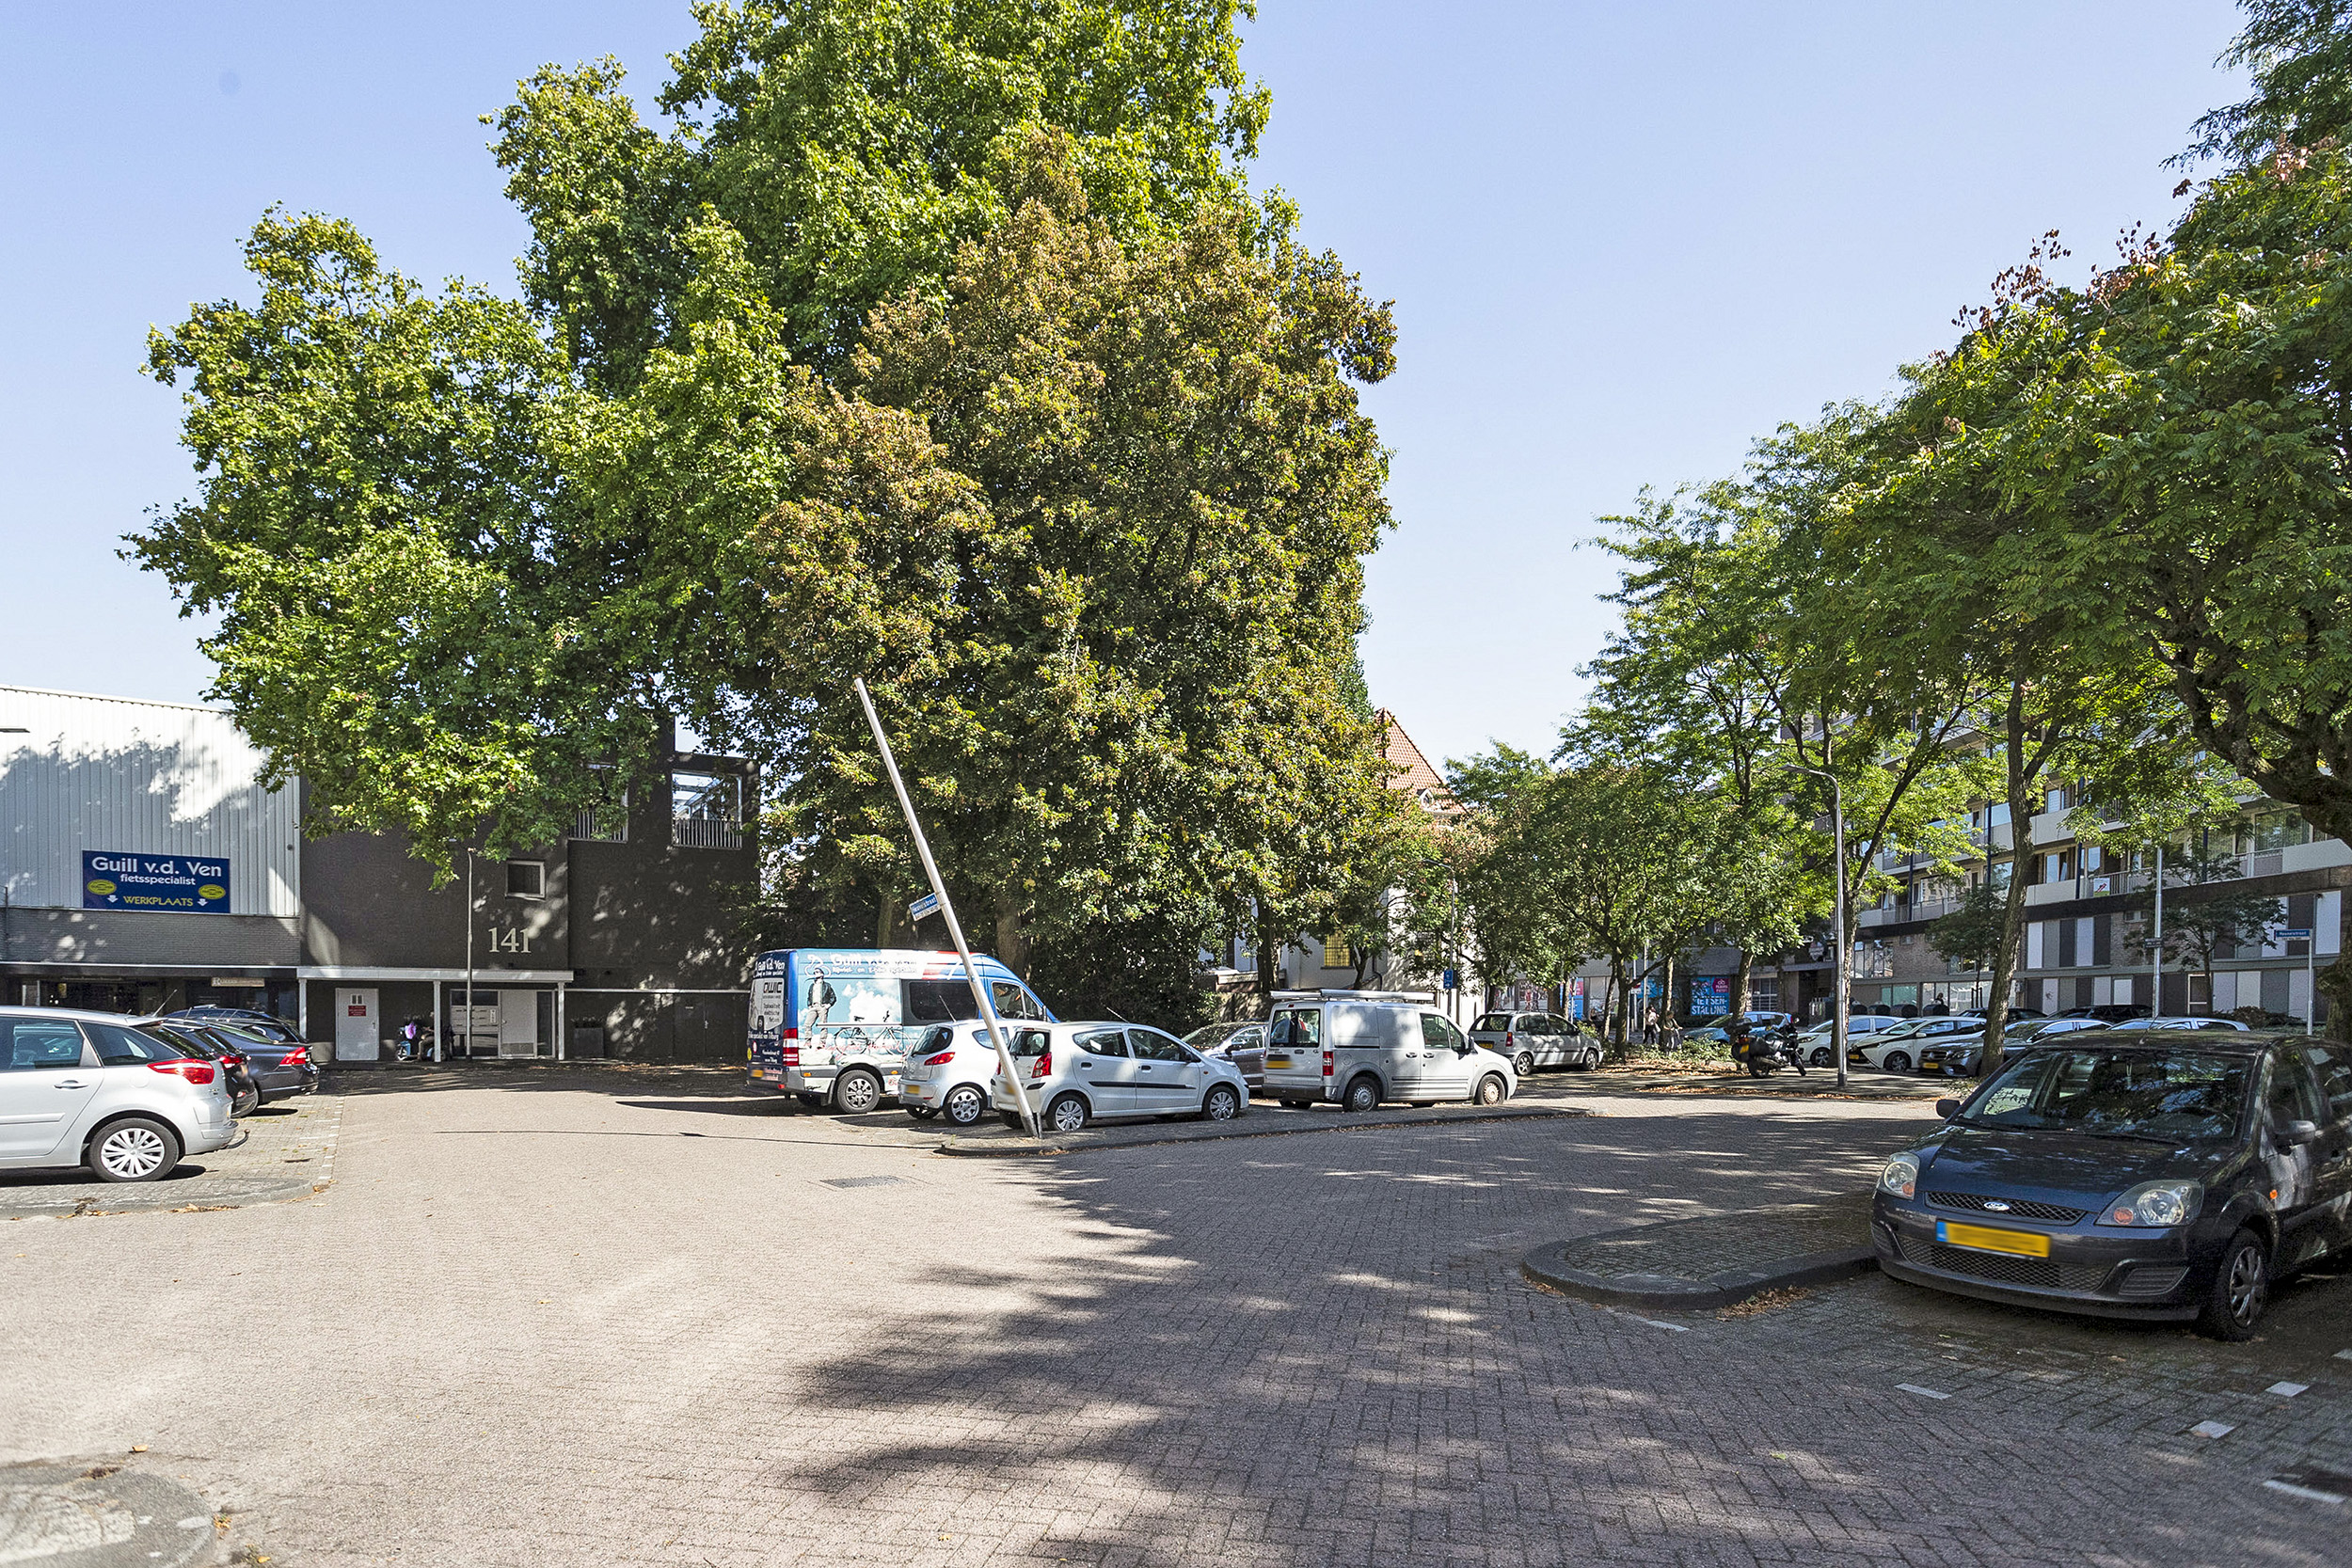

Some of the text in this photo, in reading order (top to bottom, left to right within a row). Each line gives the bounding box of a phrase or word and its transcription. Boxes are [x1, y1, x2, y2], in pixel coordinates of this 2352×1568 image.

[91, 857, 223, 879] Guill v.d. Ven
[120, 874, 196, 885] fietsspecialist
[123, 895, 194, 907] WERKPLAATS
[487, 927, 532, 954] 141
